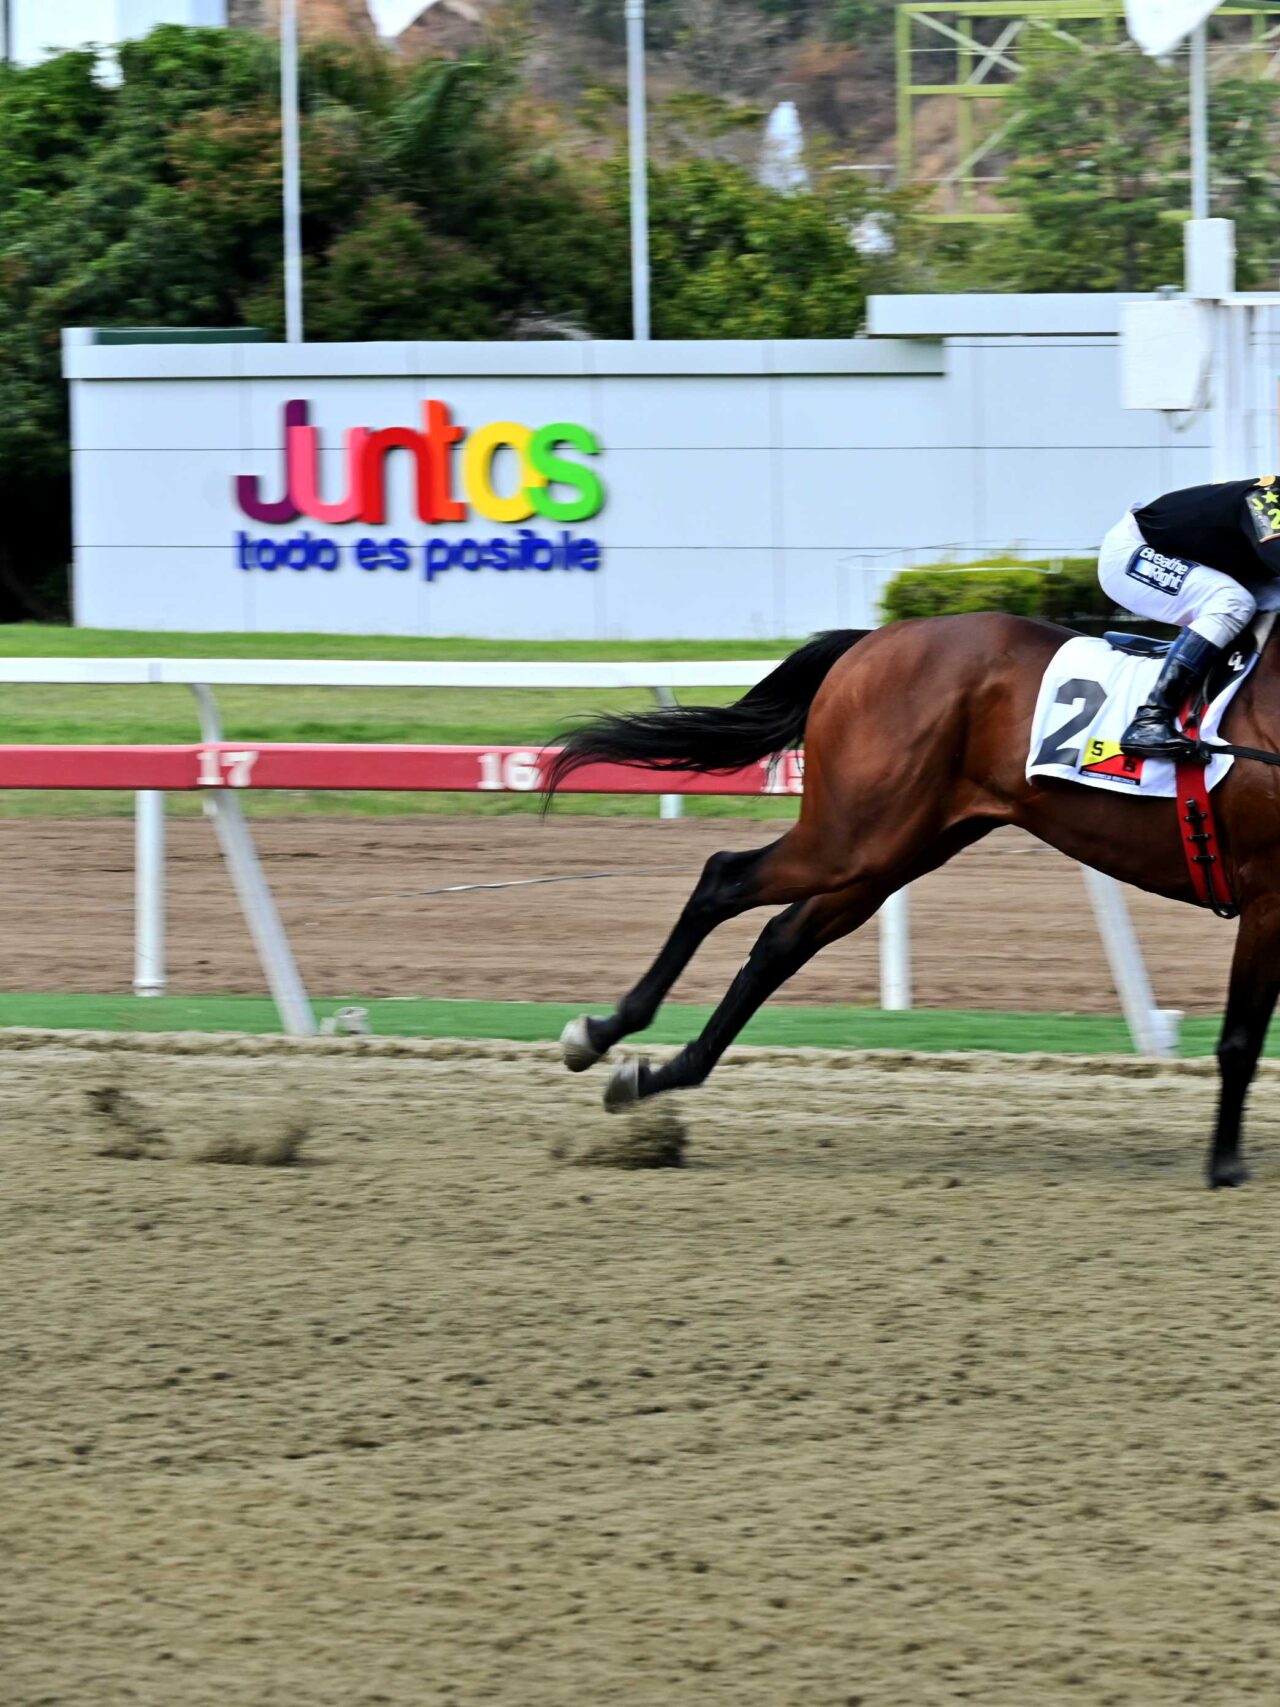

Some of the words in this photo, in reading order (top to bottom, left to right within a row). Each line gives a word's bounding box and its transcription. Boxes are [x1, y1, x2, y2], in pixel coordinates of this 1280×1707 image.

[233, 398, 606, 525] Juntos
[234, 530, 340, 571] todo
[355, 537, 412, 571] es
[423, 530, 603, 582] posible
[1139, 547, 1189, 575] Breathe
[1148, 564, 1182, 590] Right
[1030, 678, 1109, 769] 2
[195, 749, 260, 788] 17
[476, 751, 543, 791] 16
